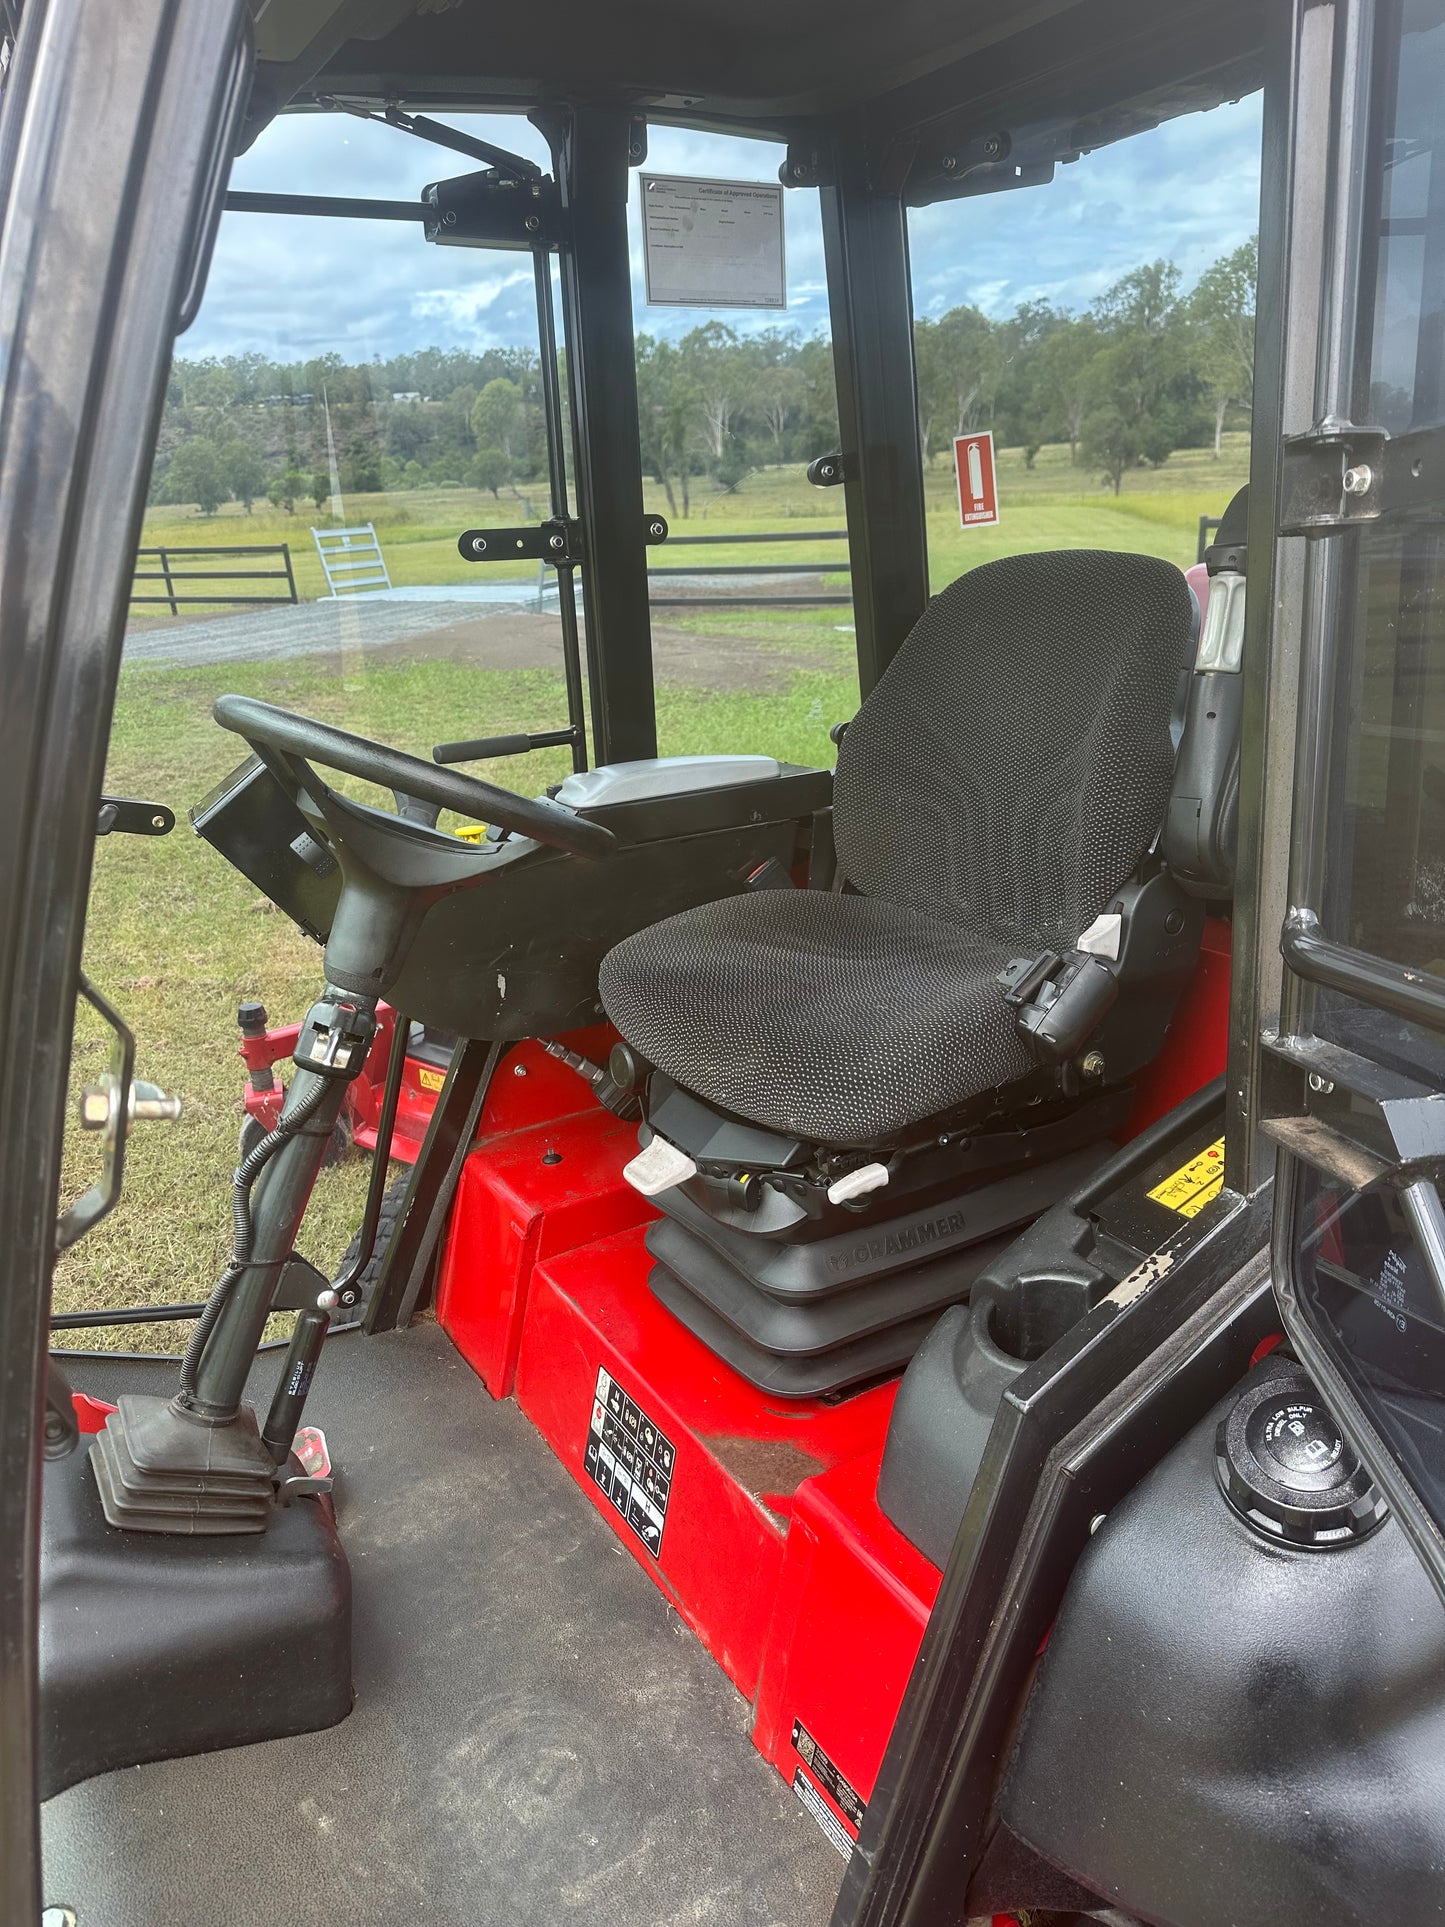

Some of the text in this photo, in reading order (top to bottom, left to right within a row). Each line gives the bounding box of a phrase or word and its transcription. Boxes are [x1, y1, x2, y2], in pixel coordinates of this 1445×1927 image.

[698, 187, 723, 196] Certificate
[729, 189, 752, 198] Approved
[753, 191, 778, 199] Operations
[853, 1211, 966, 1262] GRAMMER
[1265, 1422, 1275, 1441] ULTRA
[1271, 1409, 1285, 1421] LOW
[1274, 1412, 1307, 1437] DIESEL ONLY
[644, 1502, 651, 1513] H
